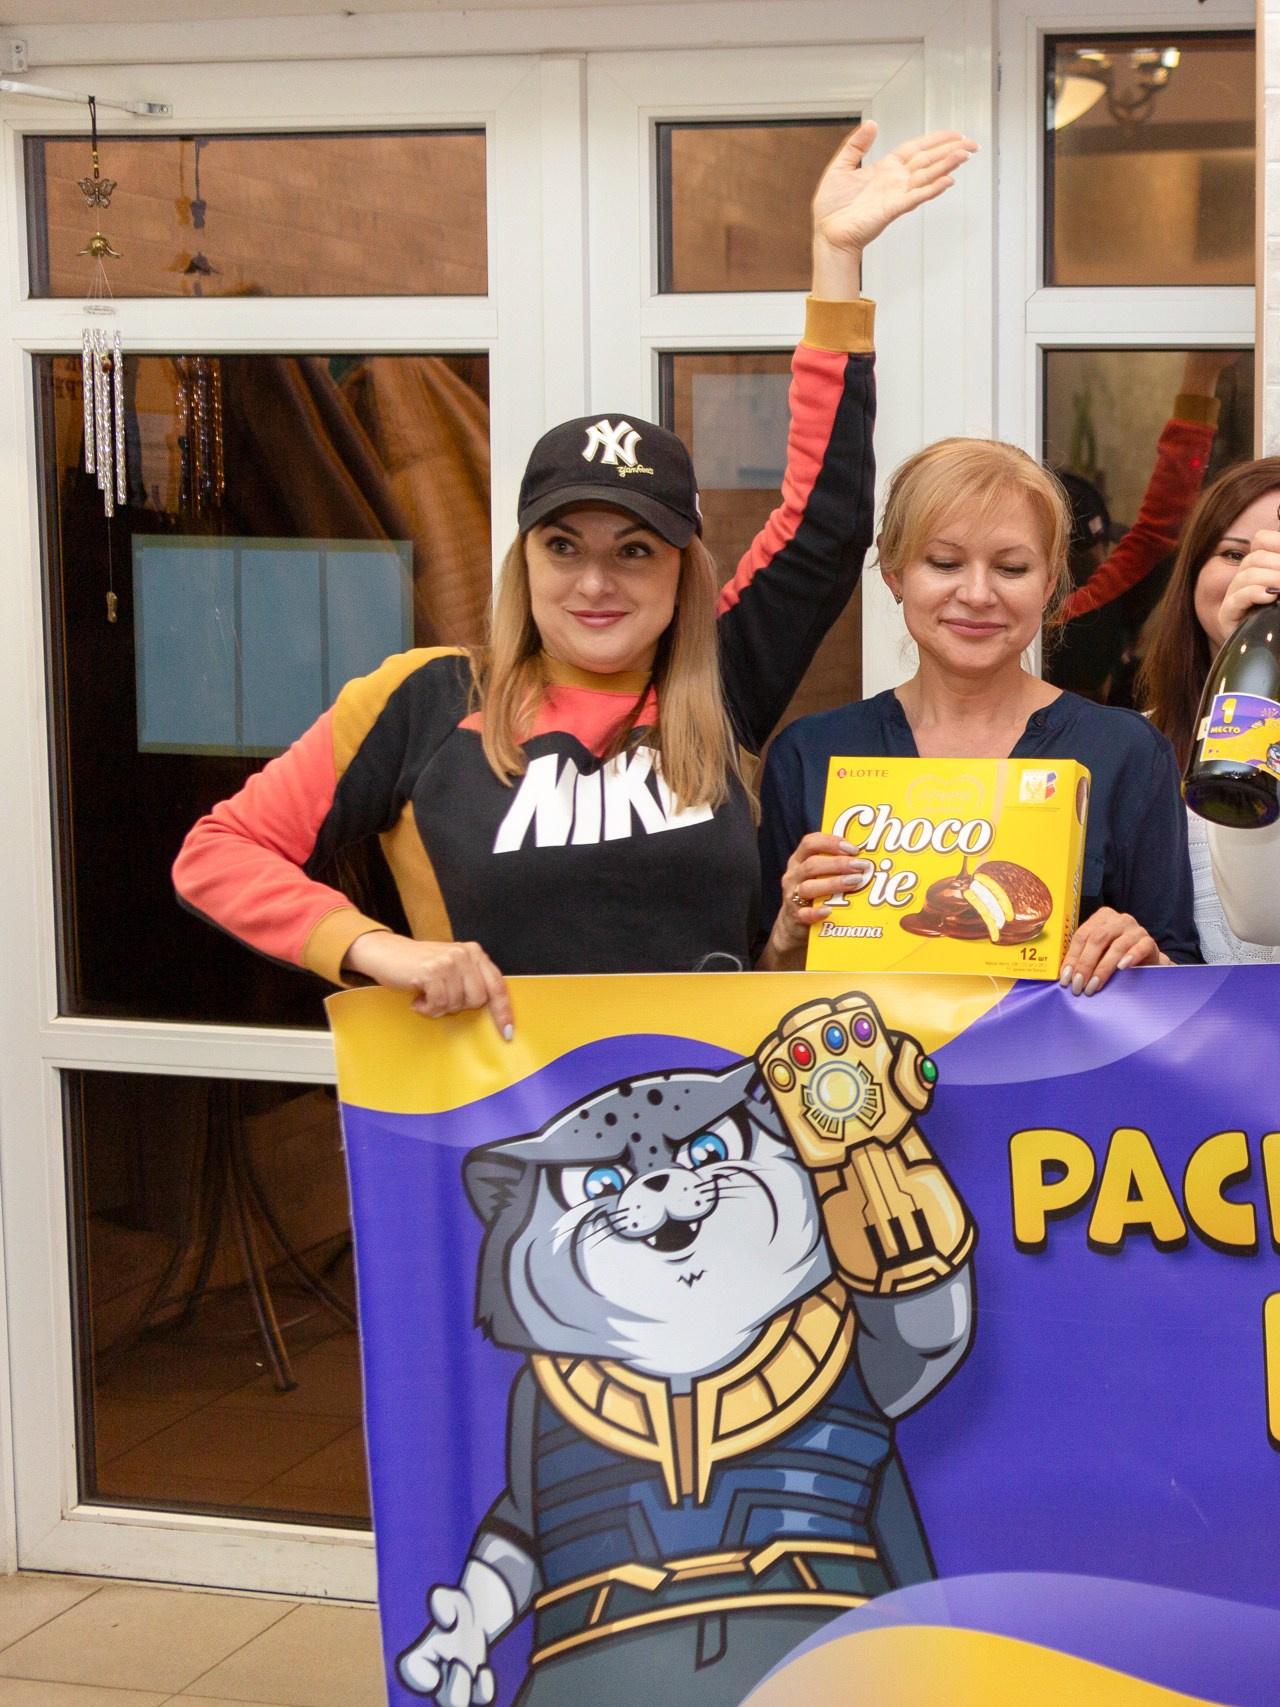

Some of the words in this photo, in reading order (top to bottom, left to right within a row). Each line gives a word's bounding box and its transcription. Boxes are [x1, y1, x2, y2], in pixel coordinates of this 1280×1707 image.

[581, 419, 642, 468] NY
[1221, 698, 1237, 724] 1
[1210, 726, 1241, 735] МЕСТО
[850, 769, 889, 778] LOTTE
[831, 804, 994, 854] Choco
[818, 922, 883, 938] Banana
[1020, 947, 1037, 961] 12
